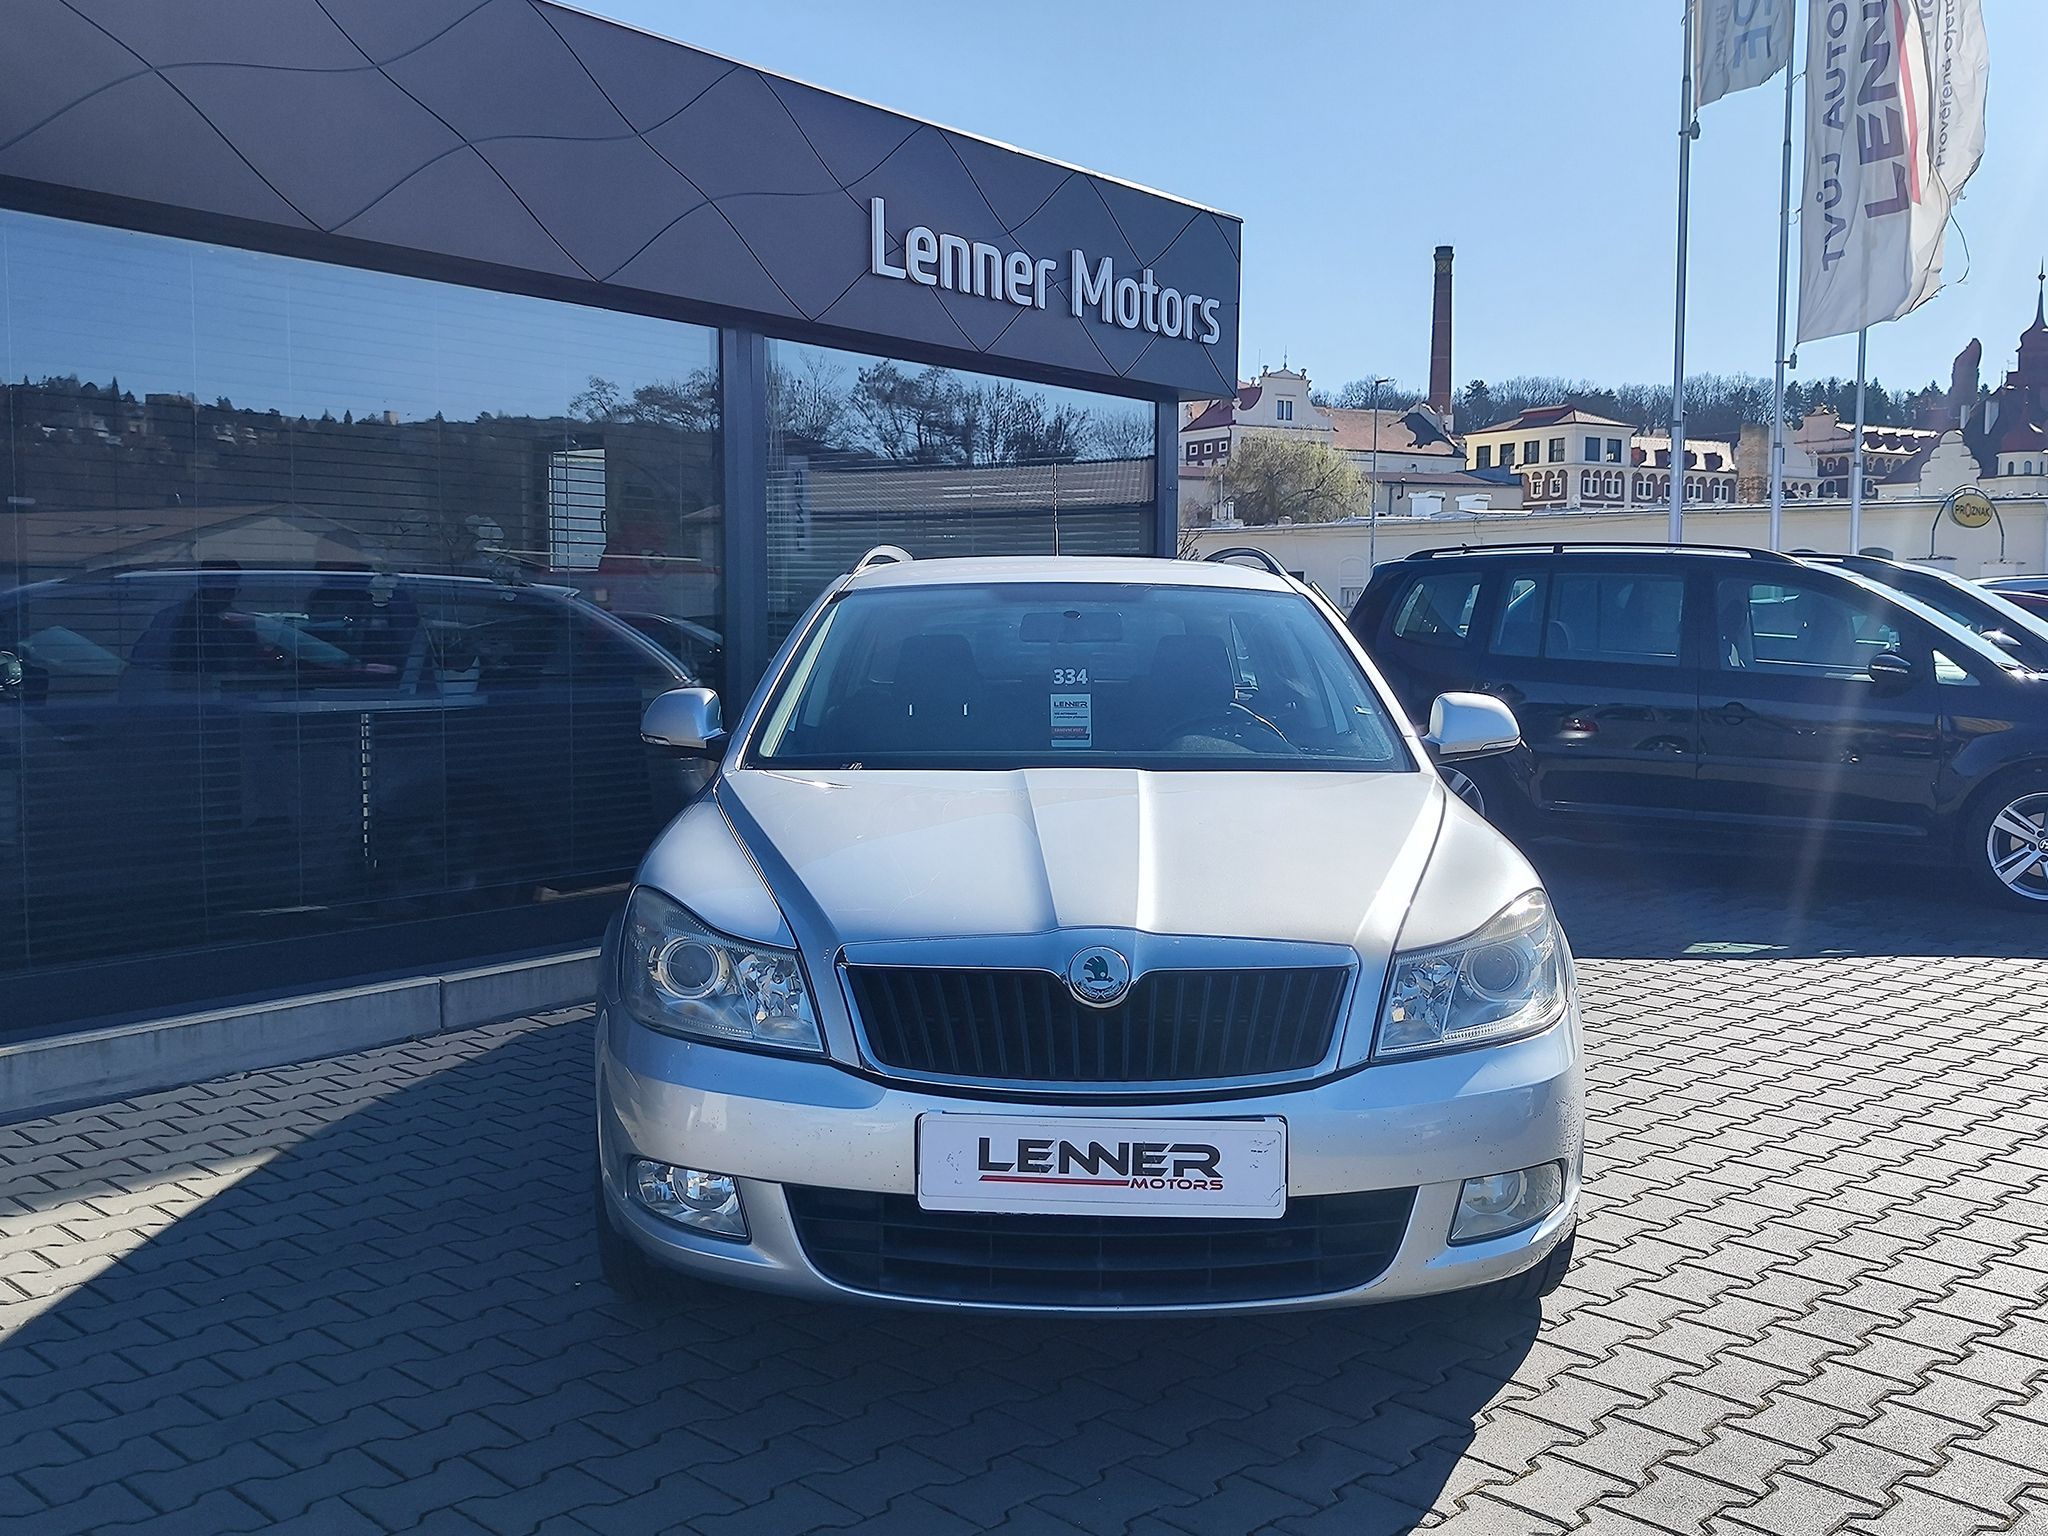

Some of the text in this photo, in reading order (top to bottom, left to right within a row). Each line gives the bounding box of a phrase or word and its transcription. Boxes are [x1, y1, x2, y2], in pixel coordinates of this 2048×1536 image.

[1816, 0, 1847, 271] TVŮJ AUTO
[1857, 0, 1909, 218] LENN
[1935, 58, 1953, 167] Prověřená
[870, 196, 1221, 345] Lenner Motors
[1053, 668, 1088, 685] 334
[978, 1137, 1223, 1179] LENNER
[1129, 1177, 1224, 1191] MOTORS
